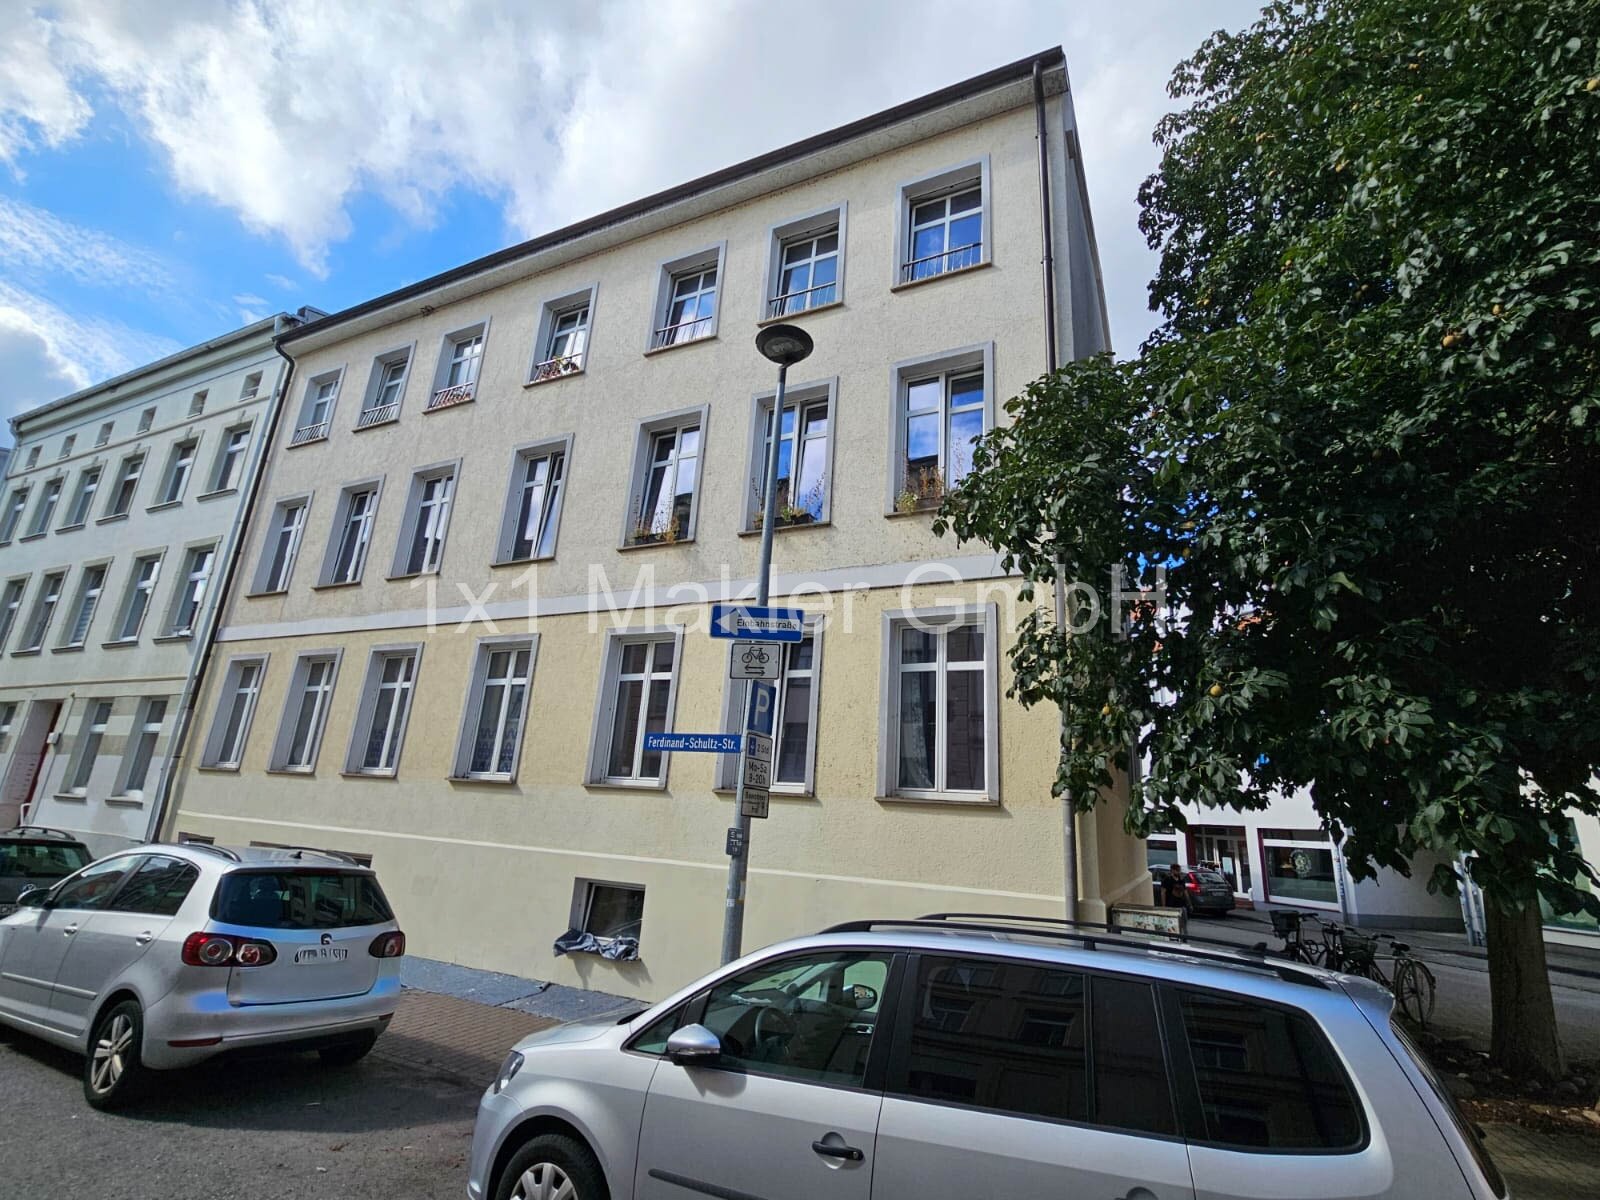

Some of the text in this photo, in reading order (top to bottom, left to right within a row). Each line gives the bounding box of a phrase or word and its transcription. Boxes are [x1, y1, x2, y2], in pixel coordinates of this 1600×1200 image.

[737, 618, 797, 630] Einbahnstraße
[754, 687, 770, 726] P
[648, 737, 736, 750] Ferdinand-Schultz-Str.
